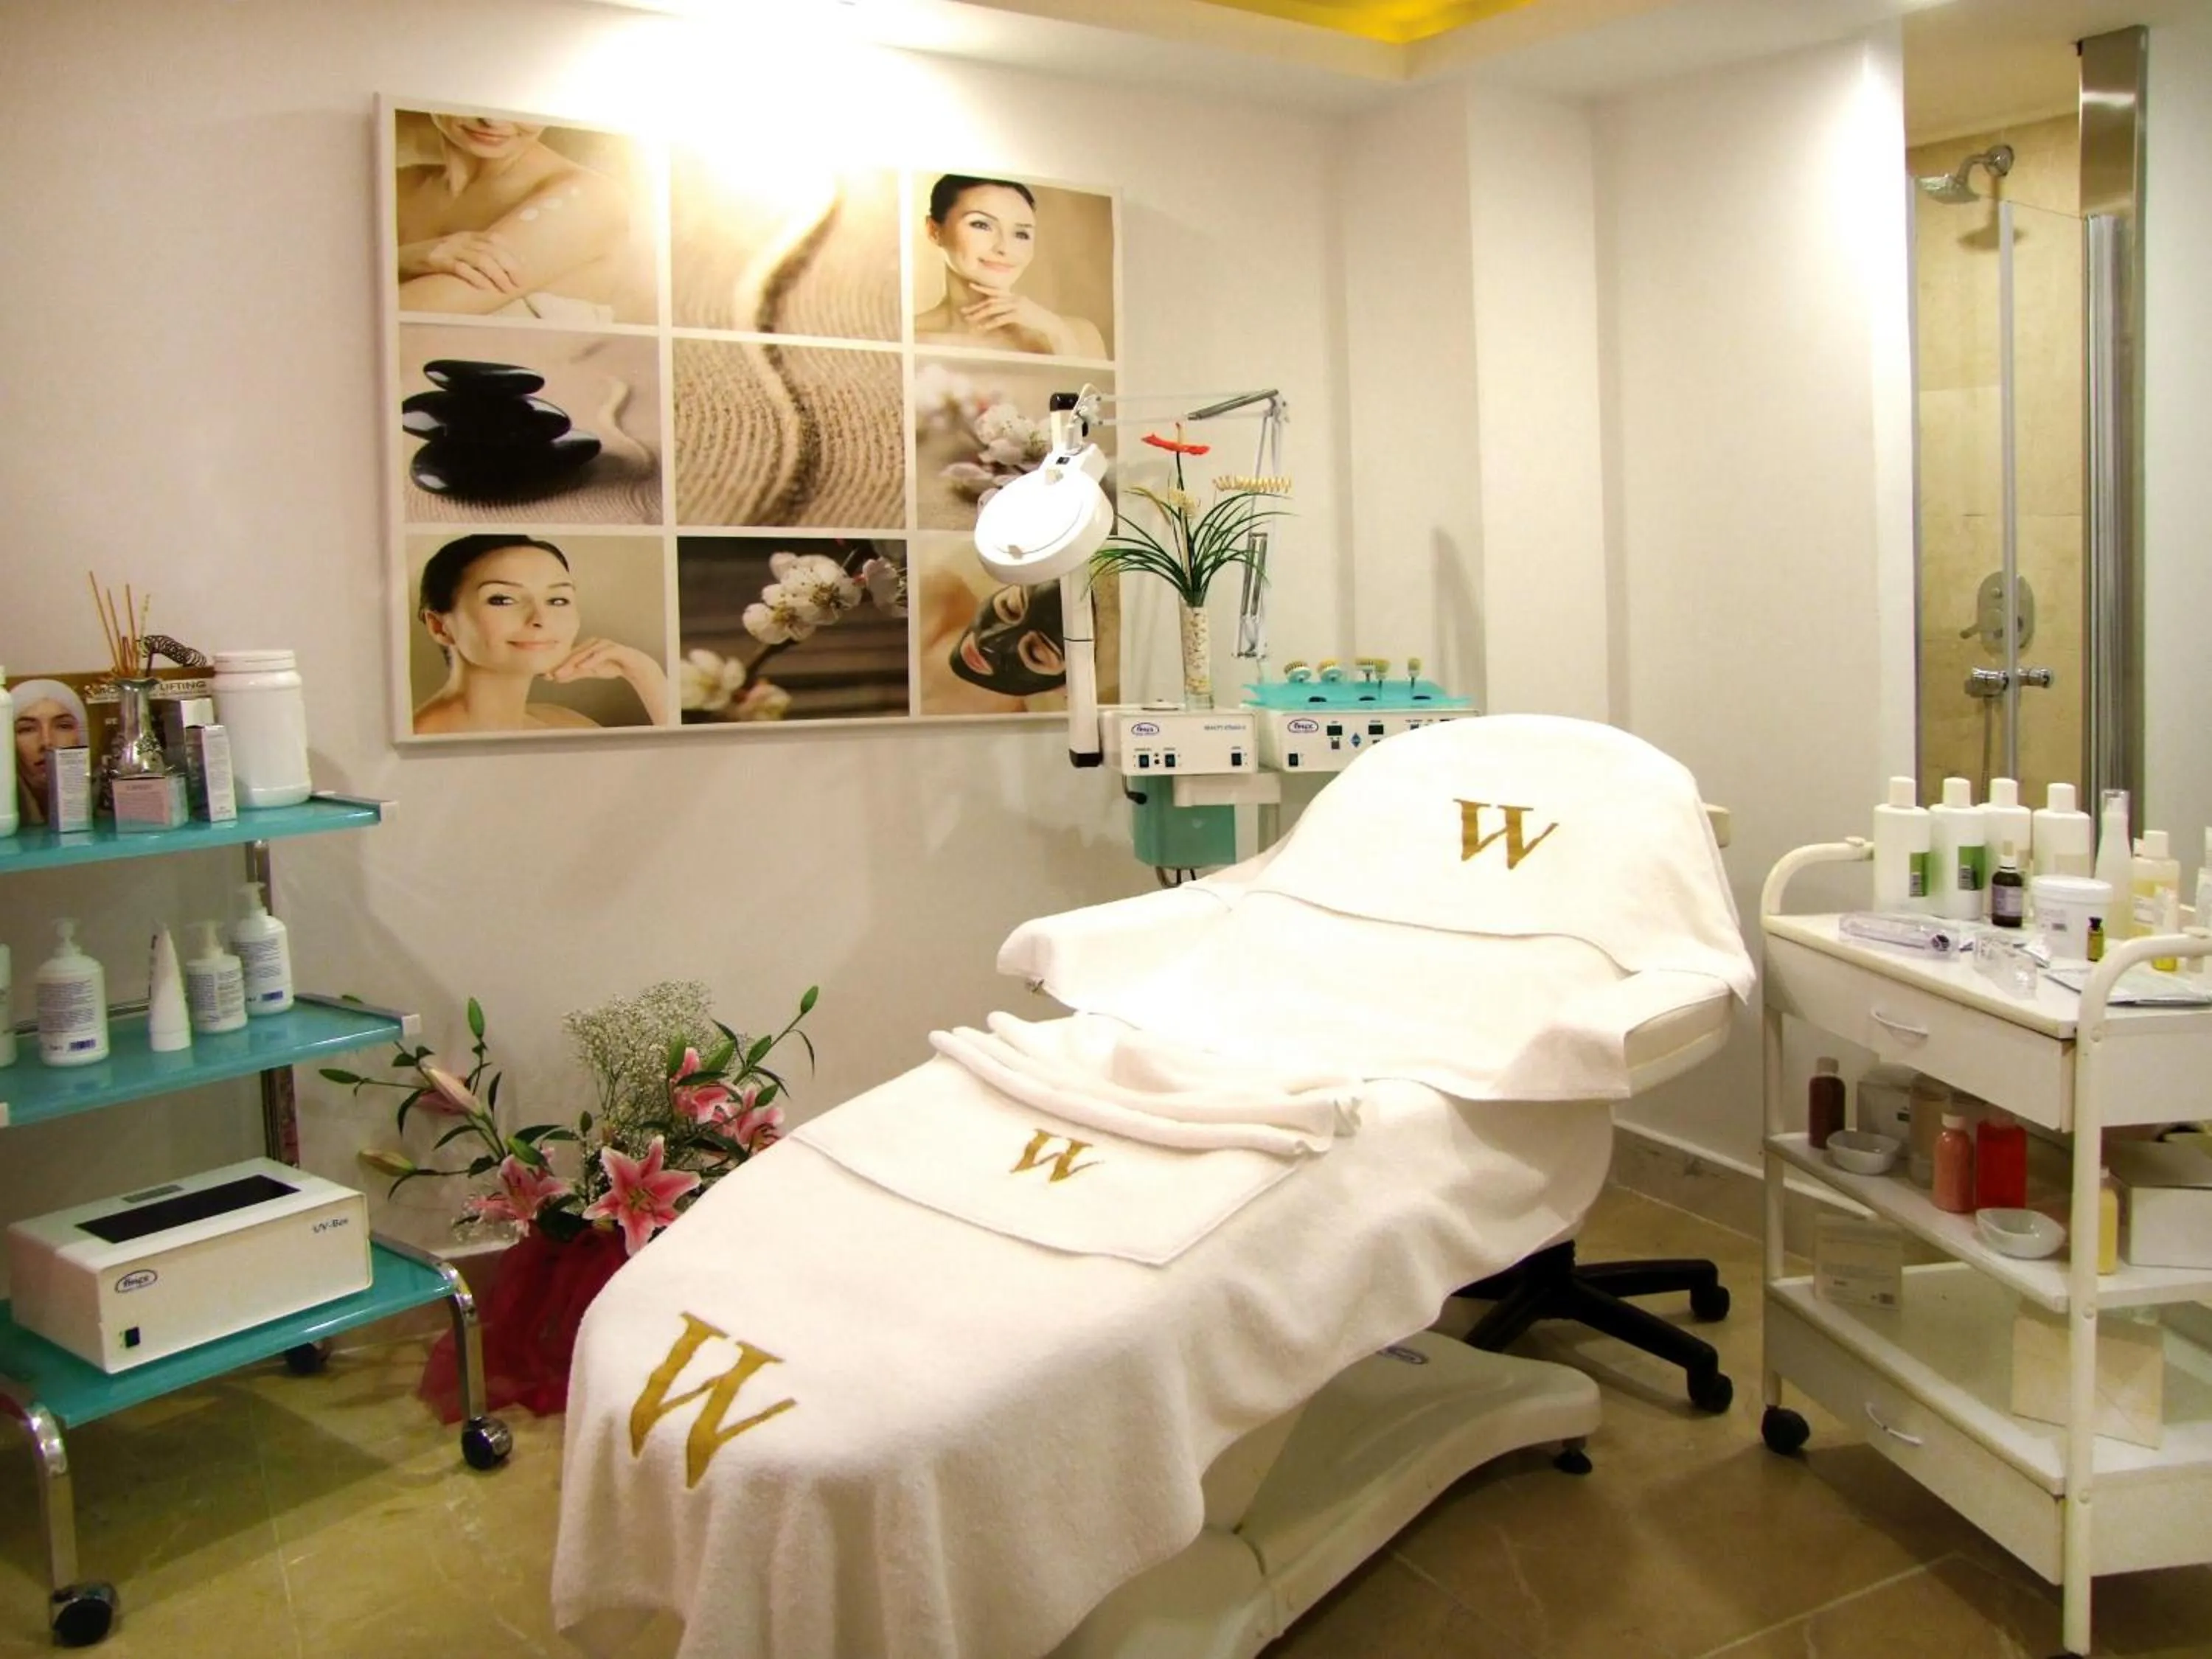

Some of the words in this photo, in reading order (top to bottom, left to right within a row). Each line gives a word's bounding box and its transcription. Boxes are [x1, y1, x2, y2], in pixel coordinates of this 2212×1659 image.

[159, 680, 206, 692] LIFTING
[1453, 799, 1559, 870] W
[1009, 1128, 1105, 1183] W
[630, 1311, 798, 1489] W
